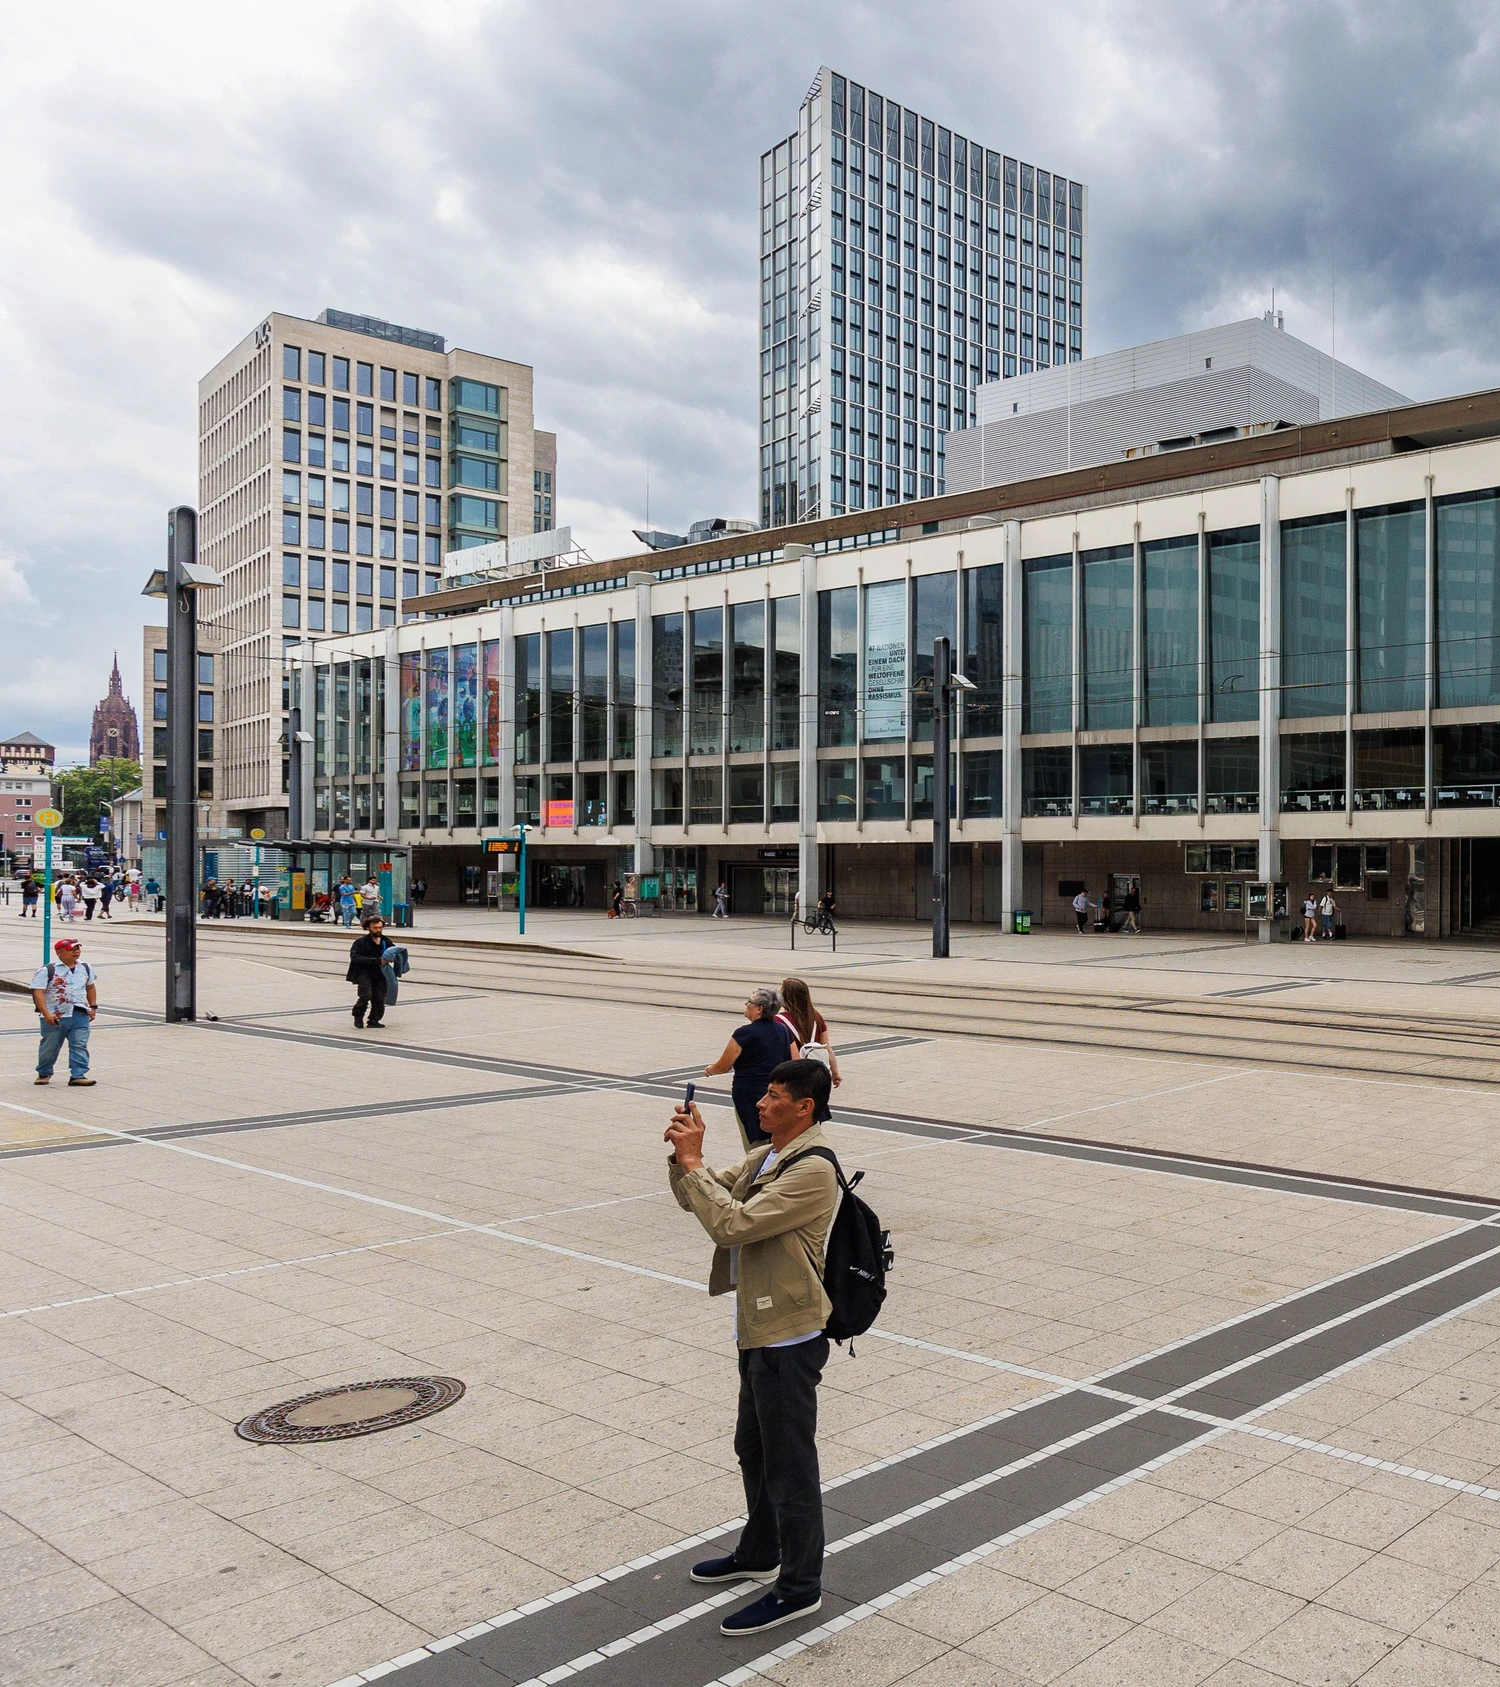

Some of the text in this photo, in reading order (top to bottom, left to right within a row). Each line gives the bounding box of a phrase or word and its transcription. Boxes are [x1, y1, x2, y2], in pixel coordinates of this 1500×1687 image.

[876, 642, 905, 651] NATIONEN
[868, 670, 905, 679] WELTOFFENE
[868, 677, 905, 687] GESELLSCHAF
[868, 691, 903, 700] RASSISMUS.
